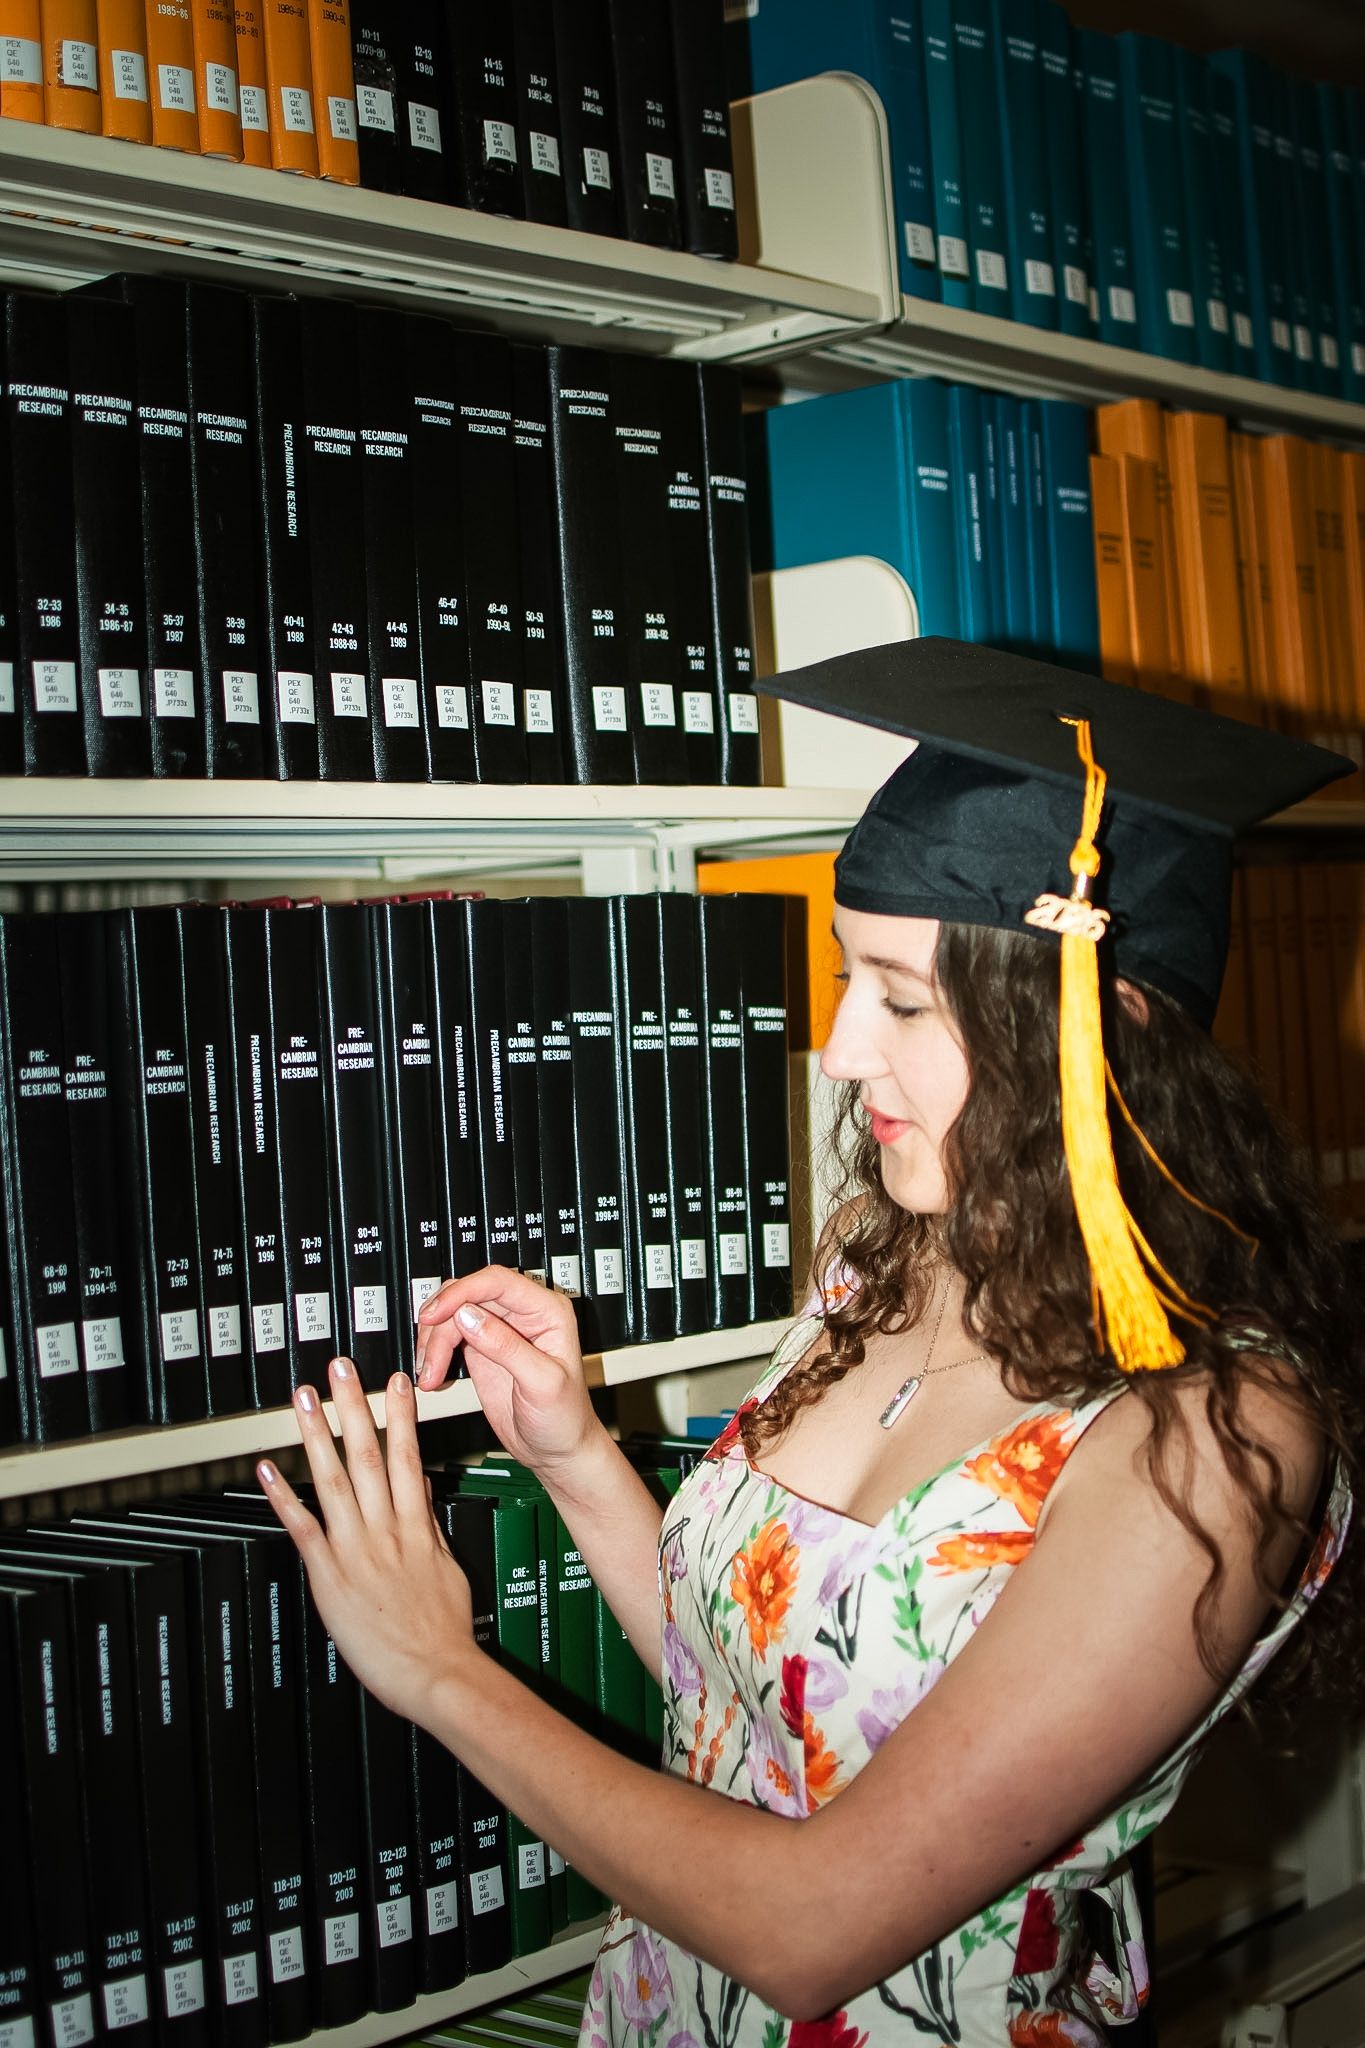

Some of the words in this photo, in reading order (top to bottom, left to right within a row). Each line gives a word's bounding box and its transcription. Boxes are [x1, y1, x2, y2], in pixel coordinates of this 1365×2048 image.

[362, 28, 380, 42] 10-11
[414, 45, 432, 60] 12-13
[121, 56, 134, 64] PEX
[484, 57, 503, 71] 14-15
[122, 65, 132, 73] QE
[167, 69, 181, 77] PEX
[415, 62, 434, 76] 1980
[168, 78, 178, 86] QE
[485, 72, 505, 87] 1981
[289, 91, 302, 99] PEX
[364, 90, 377, 99] PEX
[290, 100, 300, 108] QE
[9, 384, 68, 401] PRECAMBRIAN
[18, 401, 63, 416] RESEARCH
[75, 393, 132, 411] PRECAMBRIAN
[460, 406, 511, 421] PRECAMBRIAN
[569, 404, 606, 417] RESEARCH
[84, 410, 127, 426] RESEARCH
[197, 412, 247, 430] PRECAMBRIAN
[421, 414, 451, 427] RESEARCH
[143, 423, 183, 438] RESEARCH
[206, 428, 242, 444] RESEARCH
[306, 425, 356, 442] PRECAMBRIAN
[468, 423, 507, 436] RESEARCH
[283, 424, 295, 487] PRECAMBRIAN
[314, 441, 351, 456] RESEARCH
[677, 472, 693, 483] PRE-
[286, 485, 298, 537] RESEARCH
[669, 498, 700, 511] RESEARCH
[37, 598, 62, 613] 32-33
[104, 602, 129, 616] 34-35
[40, 615, 61, 629] 1986
[163, 614, 184, 627] 36-37
[226, 617, 246, 630] 38-39
[284, 615, 305, 628] 40-41
[439, 613, 458, 627] 1990
[526, 611, 544, 623] 50-51
[99, 619, 133, 633] 1986-87
[332, 622, 354, 636] 42-43
[386, 622, 408, 634] 44-45
[594, 625, 614, 638] 1991
[165, 630, 184, 643] 1987
[228, 632, 246, 645] 1988
[287, 631, 304, 643] 1988
[527, 627, 545, 640] 1991
[329, 637, 358, 651] 1988-89
[390, 636, 407, 649] 1989
[43, 665, 58, 674] PEX
[44, 675, 56, 684] QE
[287, 679, 301, 687] PEX
[288, 688, 299, 696] QE
[392, 685, 405, 694] PEX
[289, 697, 301, 705] 640
[677, 1008, 692, 1020] PRE-
[347, 1027, 365, 1039] PRE-
[552, 1020, 565, 1032] PRE-
[579, 1025, 612, 1037] RESEARCH
[291, 1036, 308, 1048] PRE-
[337, 1041, 373, 1055] CAMBRIAN
[29, 1050, 50, 1062] PRE-
[76, 1055, 96, 1067] PRE-
[157, 1049, 175, 1061] PRE-
[281, 1051, 317, 1063] CAMBRIAN
[454, 1025, 465, 1089] PRECAMBRIAN
[490, 1029, 502, 1092] PRECAMBRIAN
[250, 1034, 262, 1100] PRECAMBRIAN
[338, 1057, 374, 1070] RESEARCH
[20, 1066, 61, 1080] CAMBRIAN
[65, 1071, 106, 1085] CAMBRIAN
[146, 1065, 184, 1079] CAMBRIAN
[205, 1045, 218, 1113] PRECAMBRIAN
[281, 1066, 318, 1080] RESEARCH
[20, 1083, 62, 1096] RESEARCH
[66, 1087, 107, 1101] RESEARCH
[147, 1081, 185, 1094] RESEARCH
[458, 1091, 467, 1139] RESEARCH
[494, 1093, 504, 1142] RESEARCH
[254, 1102, 265, 1154] RESEARCH
[210, 1114, 222, 1165] RESEARCH
[597, 1196, 617, 1208] 92-93
[652, 1207, 667, 1218] 1999
[357, 1226, 379, 1239] 80-81
[255, 1234, 276, 1248] 76-77
[301, 1236, 322, 1249] 78-79
[354, 1241, 383, 1254] 1996-97
[423, 1235, 437, 1247] 1997
[213, 1247, 233, 1261] 74-75
[258, 1250, 275, 1264] 1996
[304, 1251, 321, 1265] 1996
[43, 1264, 68, 1278] 68-69
[89, 1266, 113, 1279] 70-71
[167, 1259, 189, 1272] 72-73
[217, 1262, 233, 1276] 1995
[48, 1280, 67, 1294] 1994
[170, 1274, 188, 1287] 1995
[84, 1281, 118, 1297] 1994-95
[304, 1297, 317, 1305] PEX
[305, 1306, 316, 1314] QE
[306, 1315, 317, 1323] 640
[512, 1568, 530, 1578] CRE-
[565, 1564, 588, 1575] CEOUS
[506, 1580, 536, 1593] TACEOUS
[539, 1559, 548, 1616] CRETACEOUS
[559, 1577, 592, 1591] RESEARCH
[504, 1595, 538, 1609] RESEARCH
[271, 1582, 280, 1641] PRECAMBRIAN
[222, 1601, 232, 1662] PRECAMBRIAN
[541, 1617, 550, 1663] RESEARCH
[98, 1624, 110, 1686] PRECAMBRIAN
[41, 1640, 55, 1705] PRECAMBRIAN
[273, 1644, 281, 1688] RESEARCH
[225, 1664, 233, 1709] RESEARCH
[101, 1688, 113, 1736] RESEARCH
[47, 1706, 57, 1755] RESEARCH
[473, 1816, 499, 1833] 126-127
[430, 1835, 455, 1854] 124-125
[479, 1834, 496, 1849] 2003
[379, 1846, 407, 1863] 122-123
[525, 1850, 538, 1858] PEX
[436, 1854, 452, 1870] 2003
[329, 1867, 357, 1886] 120-121
[385, 1866, 403, 1880] 2003
[477, 1873, 490, 1883] PEX
[273, 1875, 302, 1894] 118-119
[390, 1883, 402, 1895] INC
[478, 1883, 488, 1892] QE
[336, 1886, 354, 1903] 2003
[479, 1890, 490, 1900] 640
[226, 1899, 255, 1918] 116-117
[279, 1894, 298, 1911] 2002
[385, 1903, 398, 1914] PEX
[386, 1913, 396, 1922] QE
[166, 1917, 196, 1936] 114-115
[232, 1918, 252, 1935] 2002
[108, 1930, 139, 1950] 112-113
[173, 1936, 194, 1953] 2002
[107, 1949, 142, 1969] 2001-02
